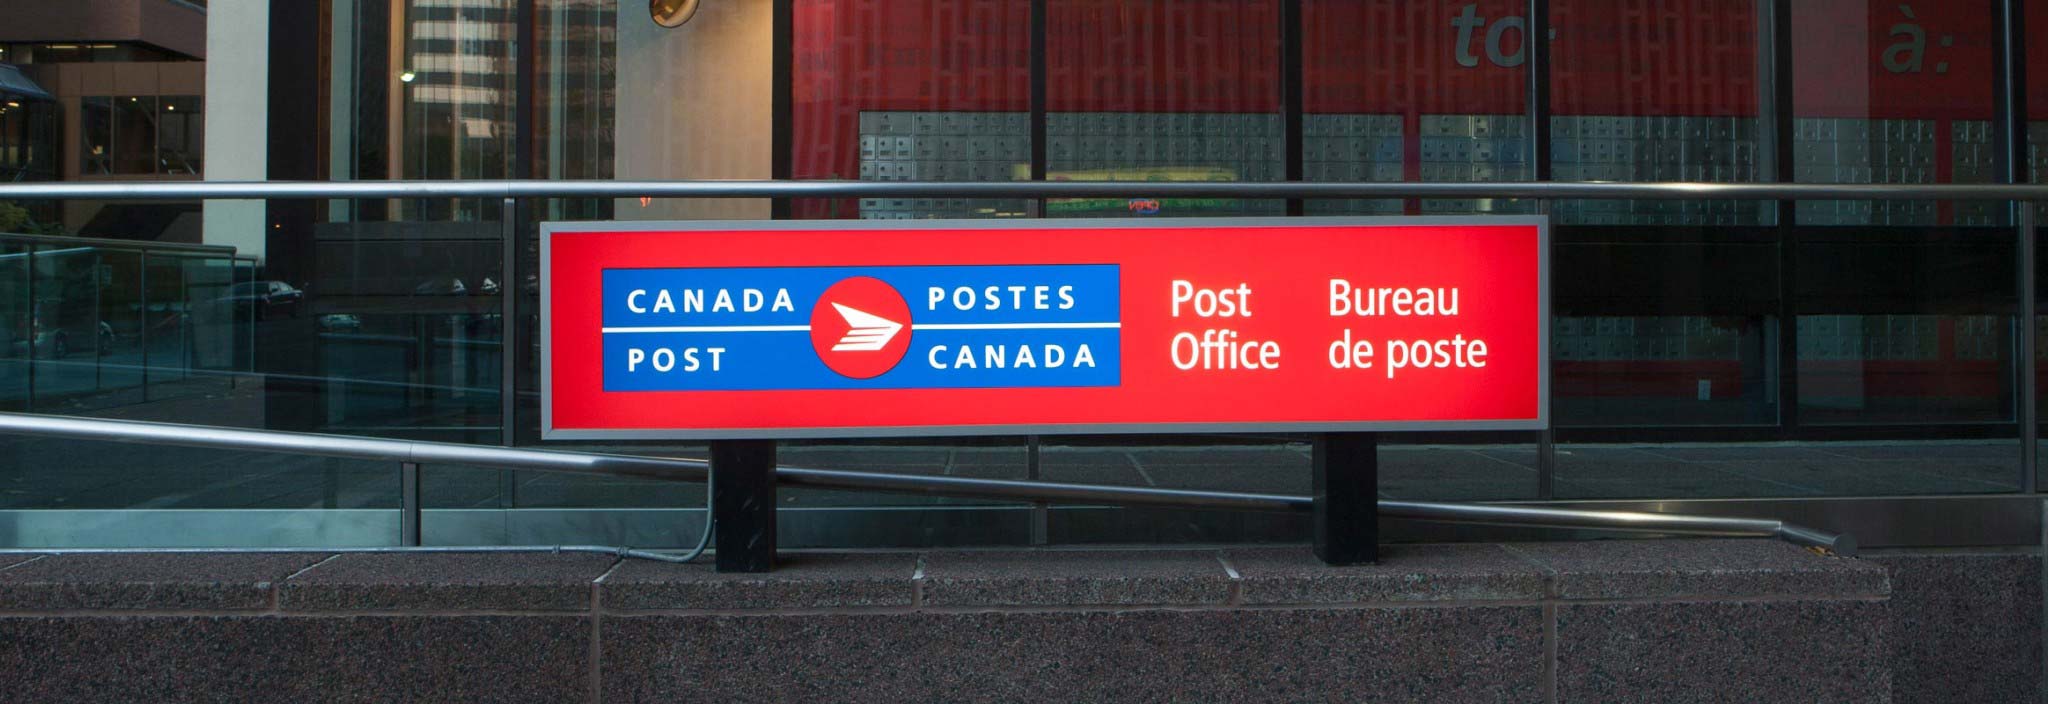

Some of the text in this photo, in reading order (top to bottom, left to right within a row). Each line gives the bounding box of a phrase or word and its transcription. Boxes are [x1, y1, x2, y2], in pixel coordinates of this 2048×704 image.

[1882, 3, 1954, 73] à:
[627, 287, 795, 314] CANADA
[928, 285, 1075, 311] POSTES
[1171, 279, 1253, 318] Post
[1329, 278, 1459, 317] Bureau
[628, 347, 726, 372] POST
[928, 343, 1096, 370] CANADA
[1170, 328, 1281, 371] Office
[1328, 328, 1488, 379] de poste
